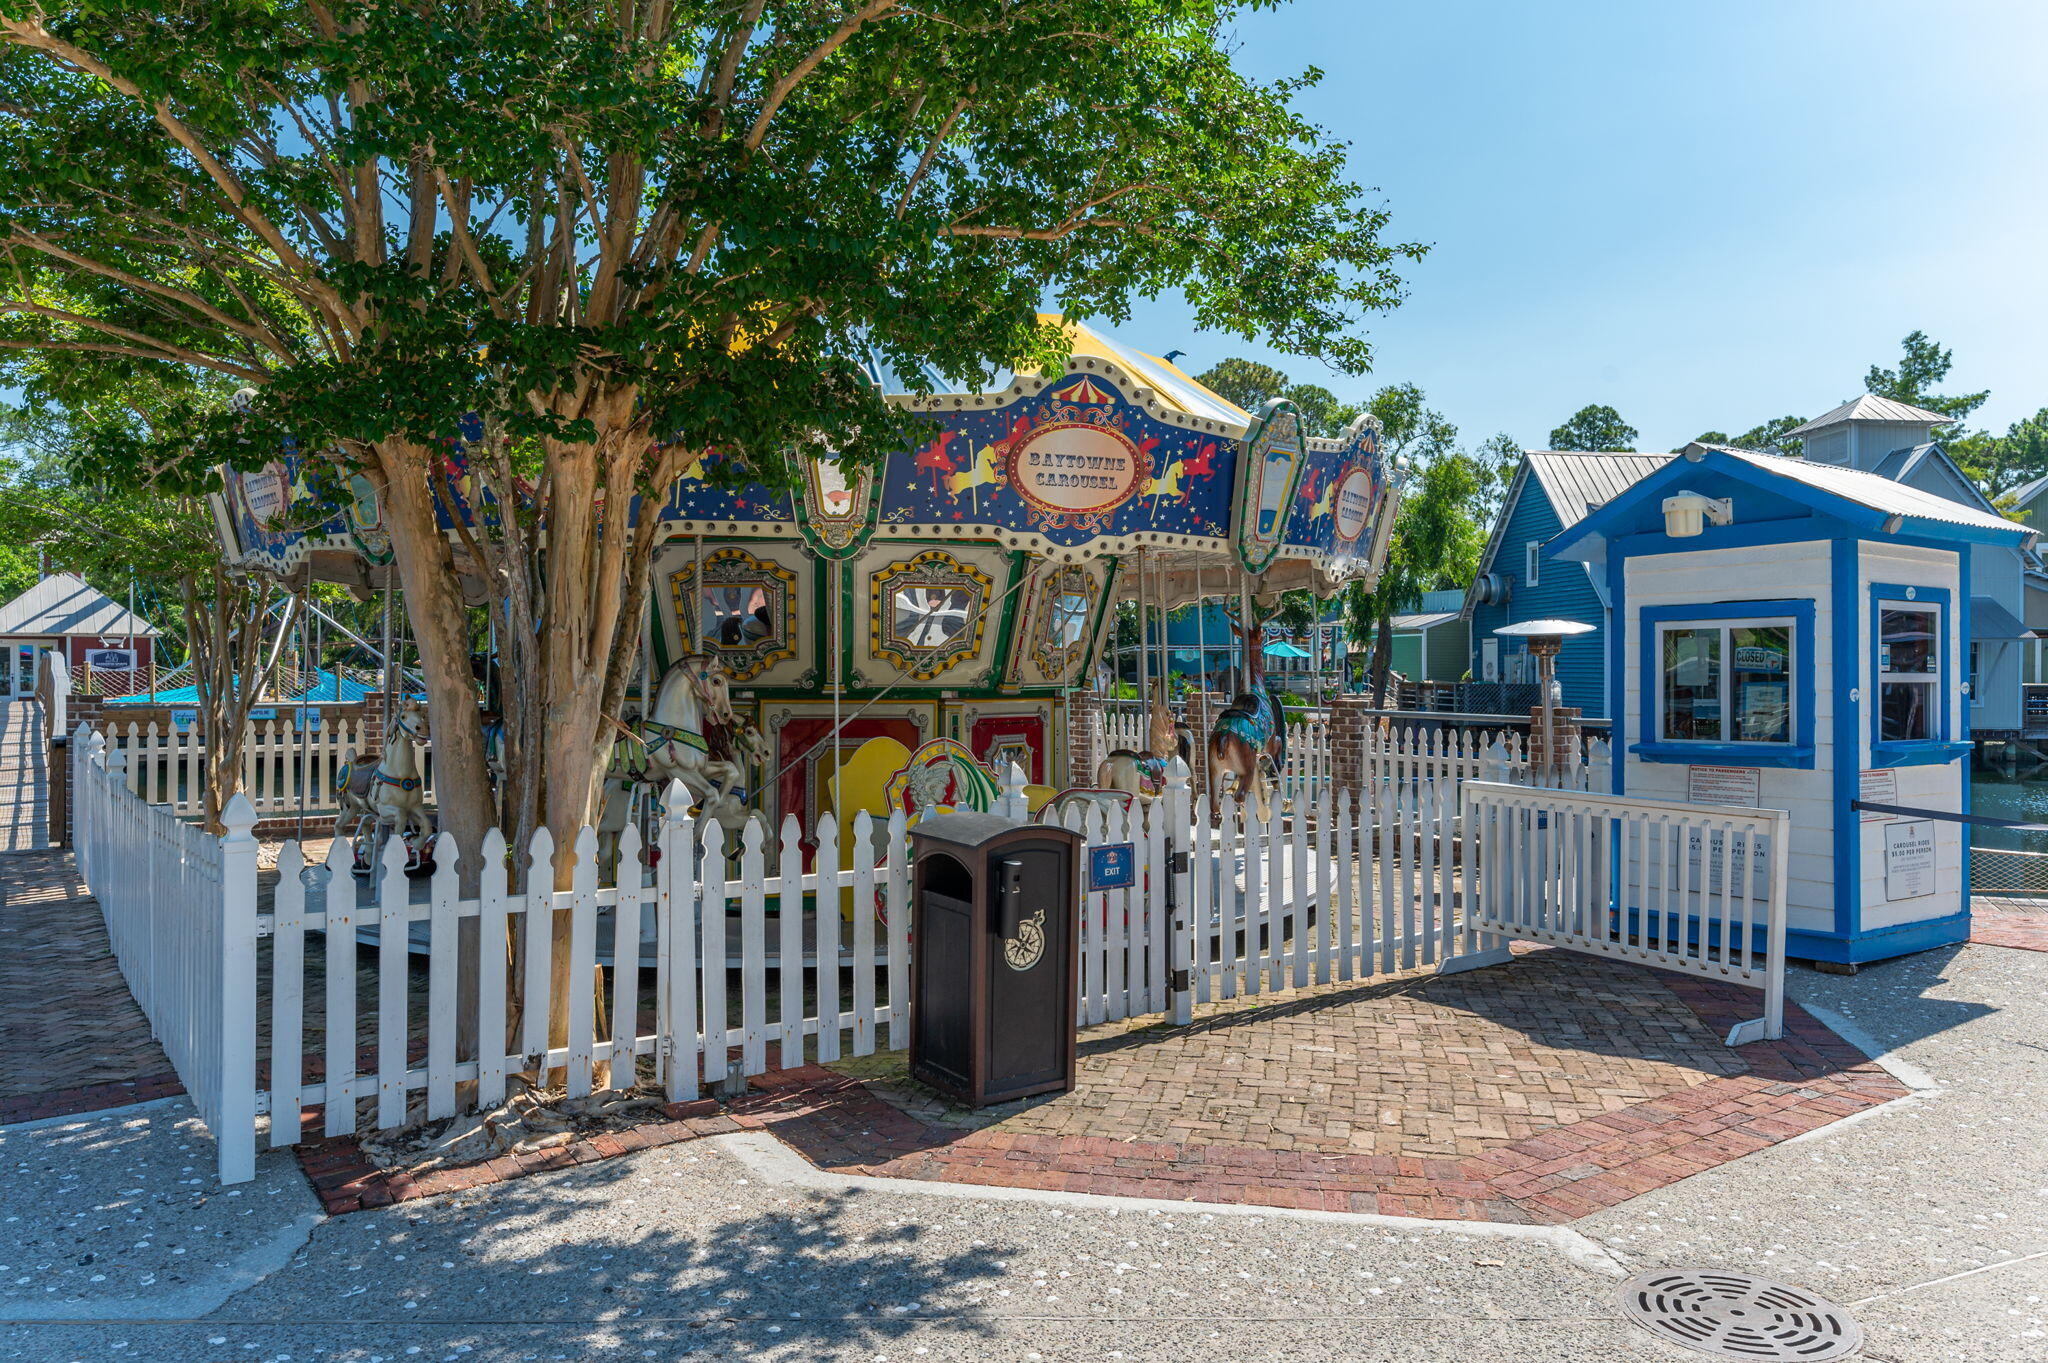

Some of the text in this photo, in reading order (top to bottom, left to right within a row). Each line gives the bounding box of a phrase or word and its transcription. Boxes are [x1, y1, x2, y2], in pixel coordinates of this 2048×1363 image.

[1028, 452, 1126, 471] BAYTOWNE
[1035, 472, 1118, 490] CAROUSEL
[1736, 651, 1765, 663] CLOSED
[1893, 841, 1917, 849] CAROUSEL
[1104, 867, 1120, 876] EXIT
